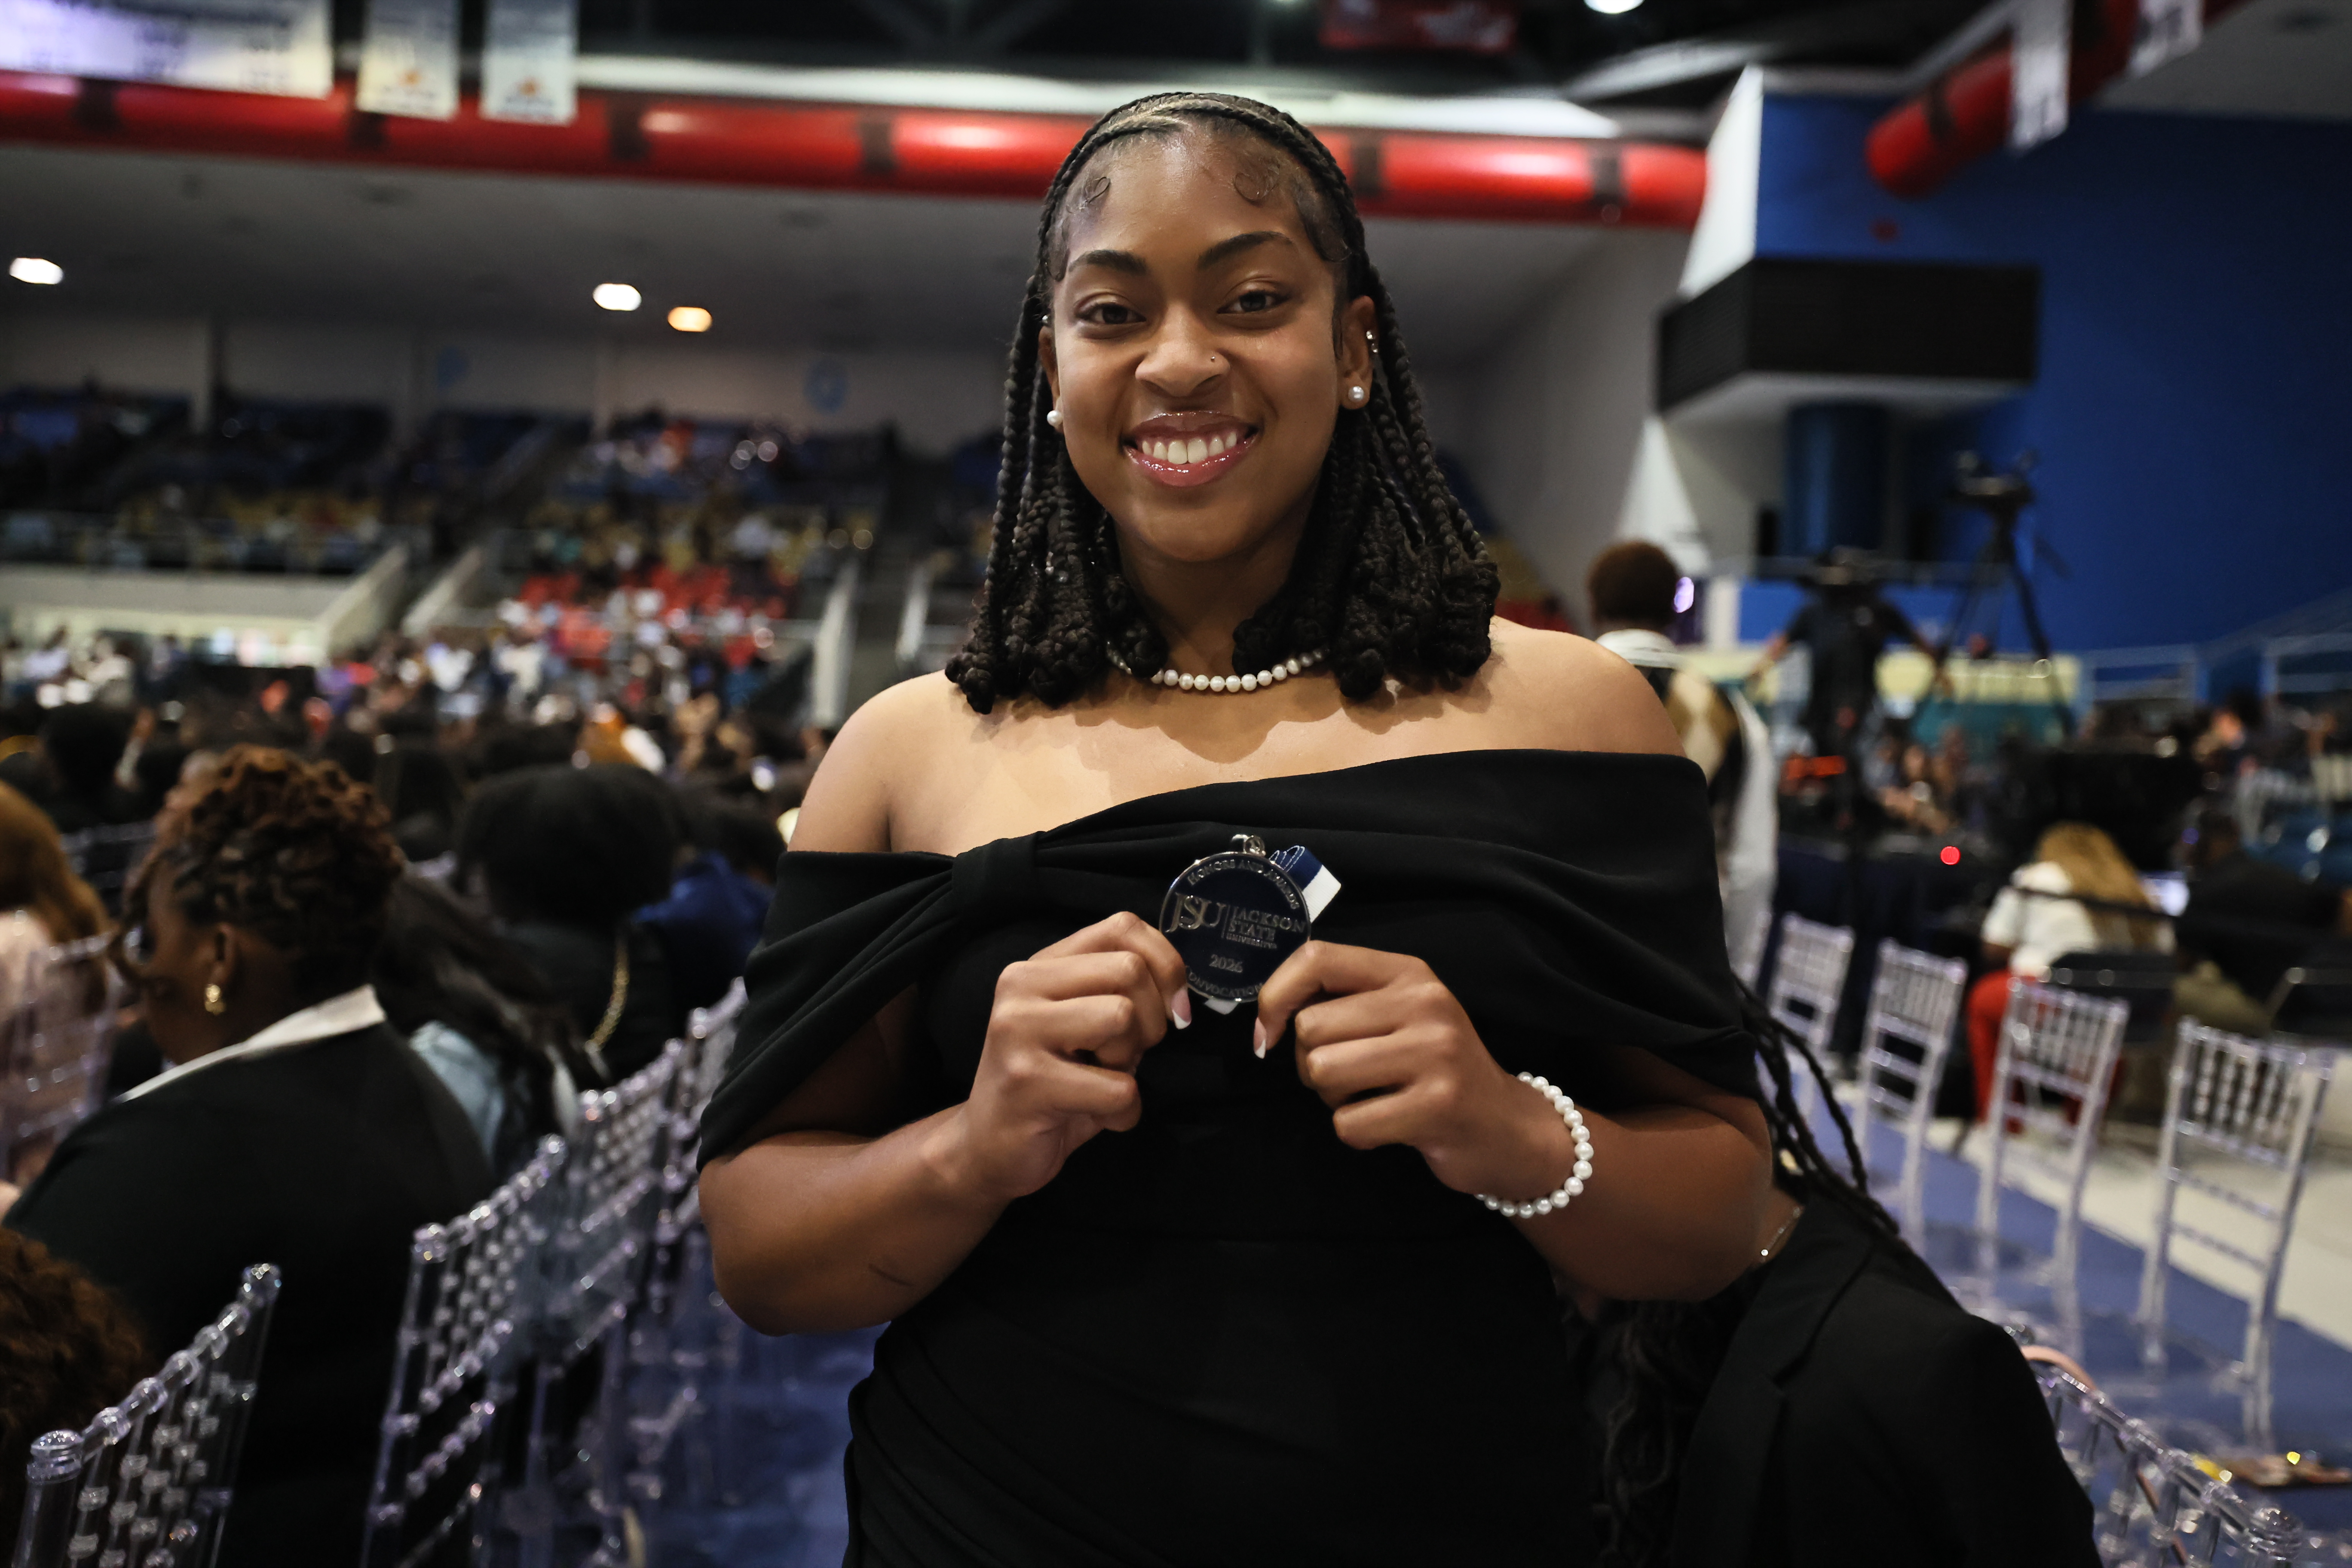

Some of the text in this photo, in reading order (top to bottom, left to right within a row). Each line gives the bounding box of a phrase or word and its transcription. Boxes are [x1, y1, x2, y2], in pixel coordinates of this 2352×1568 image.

[1239, 860, 1263, 873] AND
[1165, 892, 1226, 932] JSU
[1231, 907, 1305, 933] JACKSON
[1228, 920, 1276, 941] STATE
[1210, 954, 1243, 973] 2026
